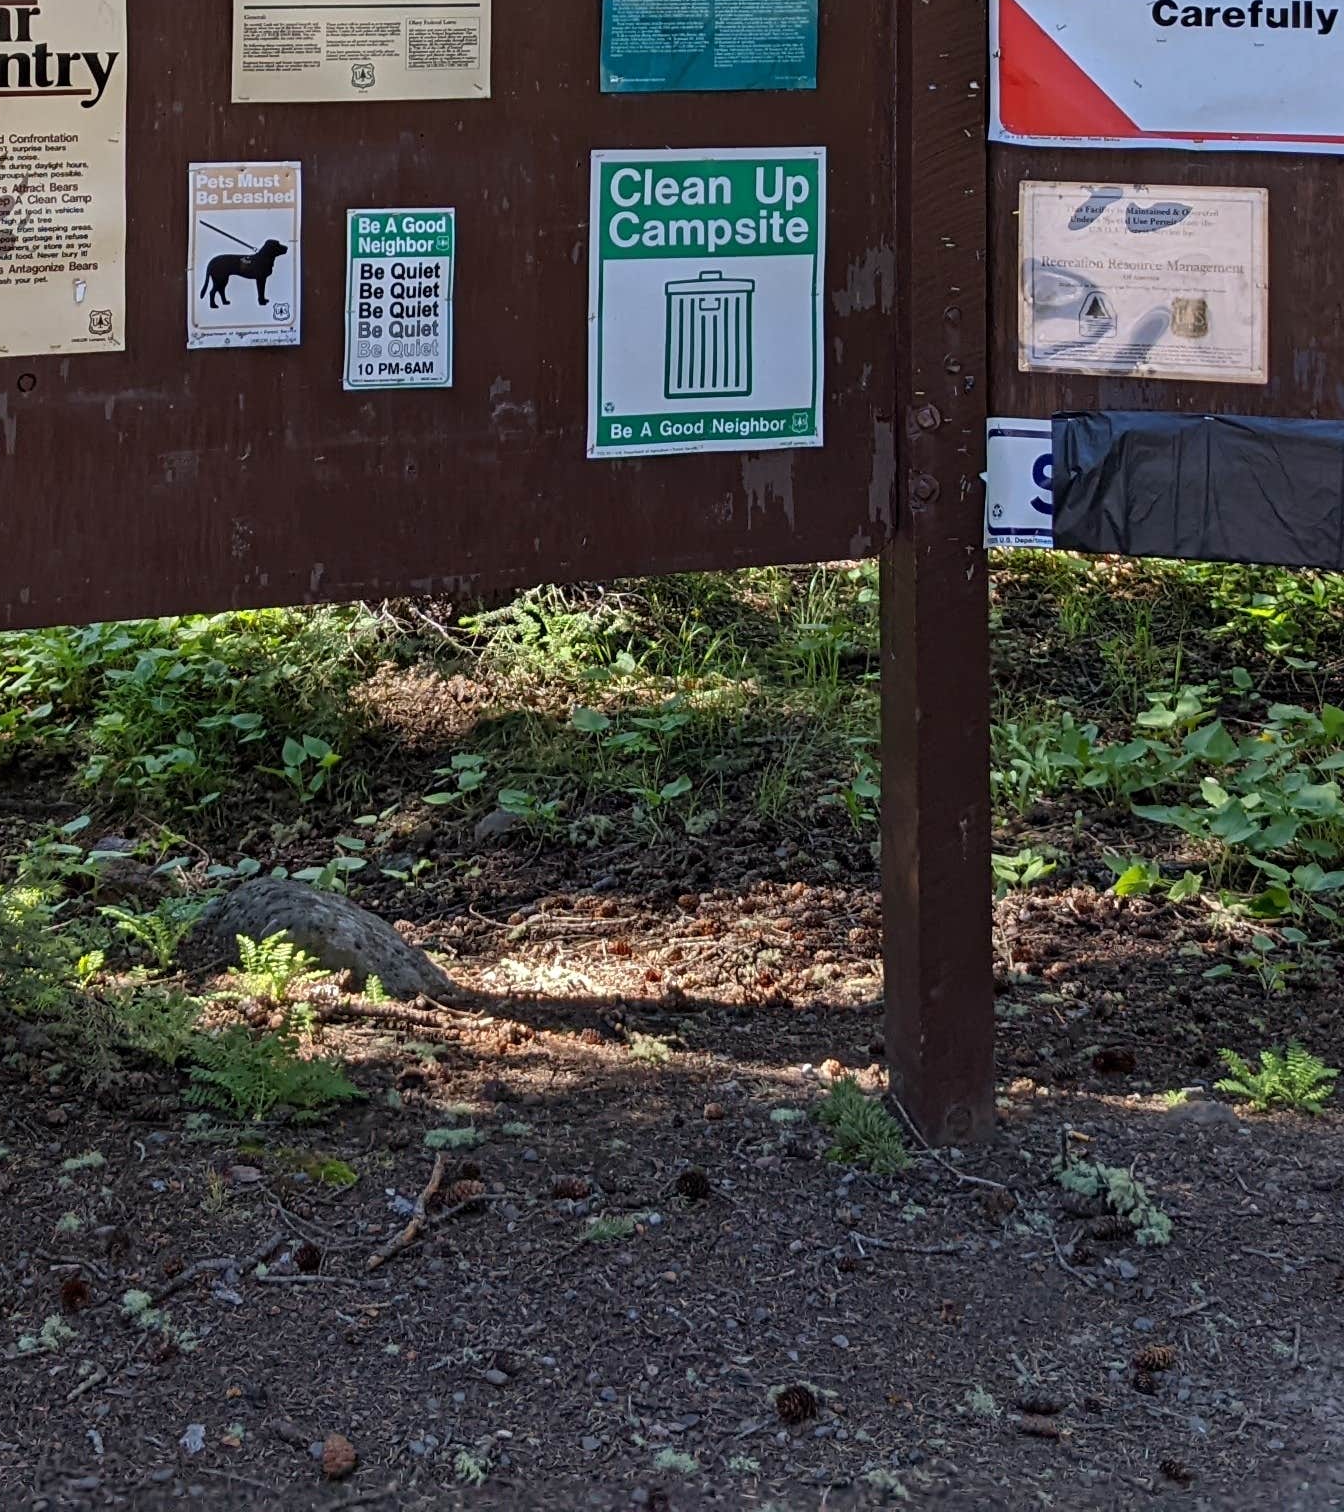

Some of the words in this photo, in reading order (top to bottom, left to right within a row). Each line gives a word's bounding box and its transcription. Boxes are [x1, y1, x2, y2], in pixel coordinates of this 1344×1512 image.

[1152, 0, 1339, 35] Carefully
[9, 133, 78, 144] Confrontation
[12, 184, 44, 194] Attract
[50, 183, 78, 192] Bears
[196, 174, 234, 188] Pets
[238, 174, 280, 187] Must
[610, 168, 732, 207] Clean
[756, 167, 809, 211] Up
[15, 196, 22, 204] A
[28, 195, 56, 204] Clean
[62, 194, 92, 204] Camp
[196, 191, 219, 204] Be
[222, 190, 294, 203] Leashed
[359, 218, 380, 234] Be
[385, 218, 397, 233] A
[402, 218, 446, 232] Good
[609, 210, 809, 252] Campsite
[358, 237, 434, 255] Neighbor
[9, 263, 64, 274] Antagonize
[69, 261, 98, 271] Bears
[360, 263, 385, 280] Be
[391, 262, 441, 280] Quiet
[1042, 256, 1105, 269] Recreation
[1108, 258, 1163, 271] Resource
[1167, 259, 1244, 275] Management
[359, 283, 384, 299] Be
[390, 282, 440, 300] Quiet
[359, 303, 383, 319] Be
[390, 301, 439, 320] Quiet
[358, 322, 383, 338] Be
[389, 321, 439, 339] Quiet
[357, 340, 382, 358] Be
[388, 340, 439, 358] Quiet
[358, 363, 374, 376] 10
[378, 362, 434, 375] PM-6AM
[611, 424, 632, 438] Be
[640, 423, 652, 437] A
[660, 420, 704, 435] Good
[712, 418, 786, 435] Neighbor
